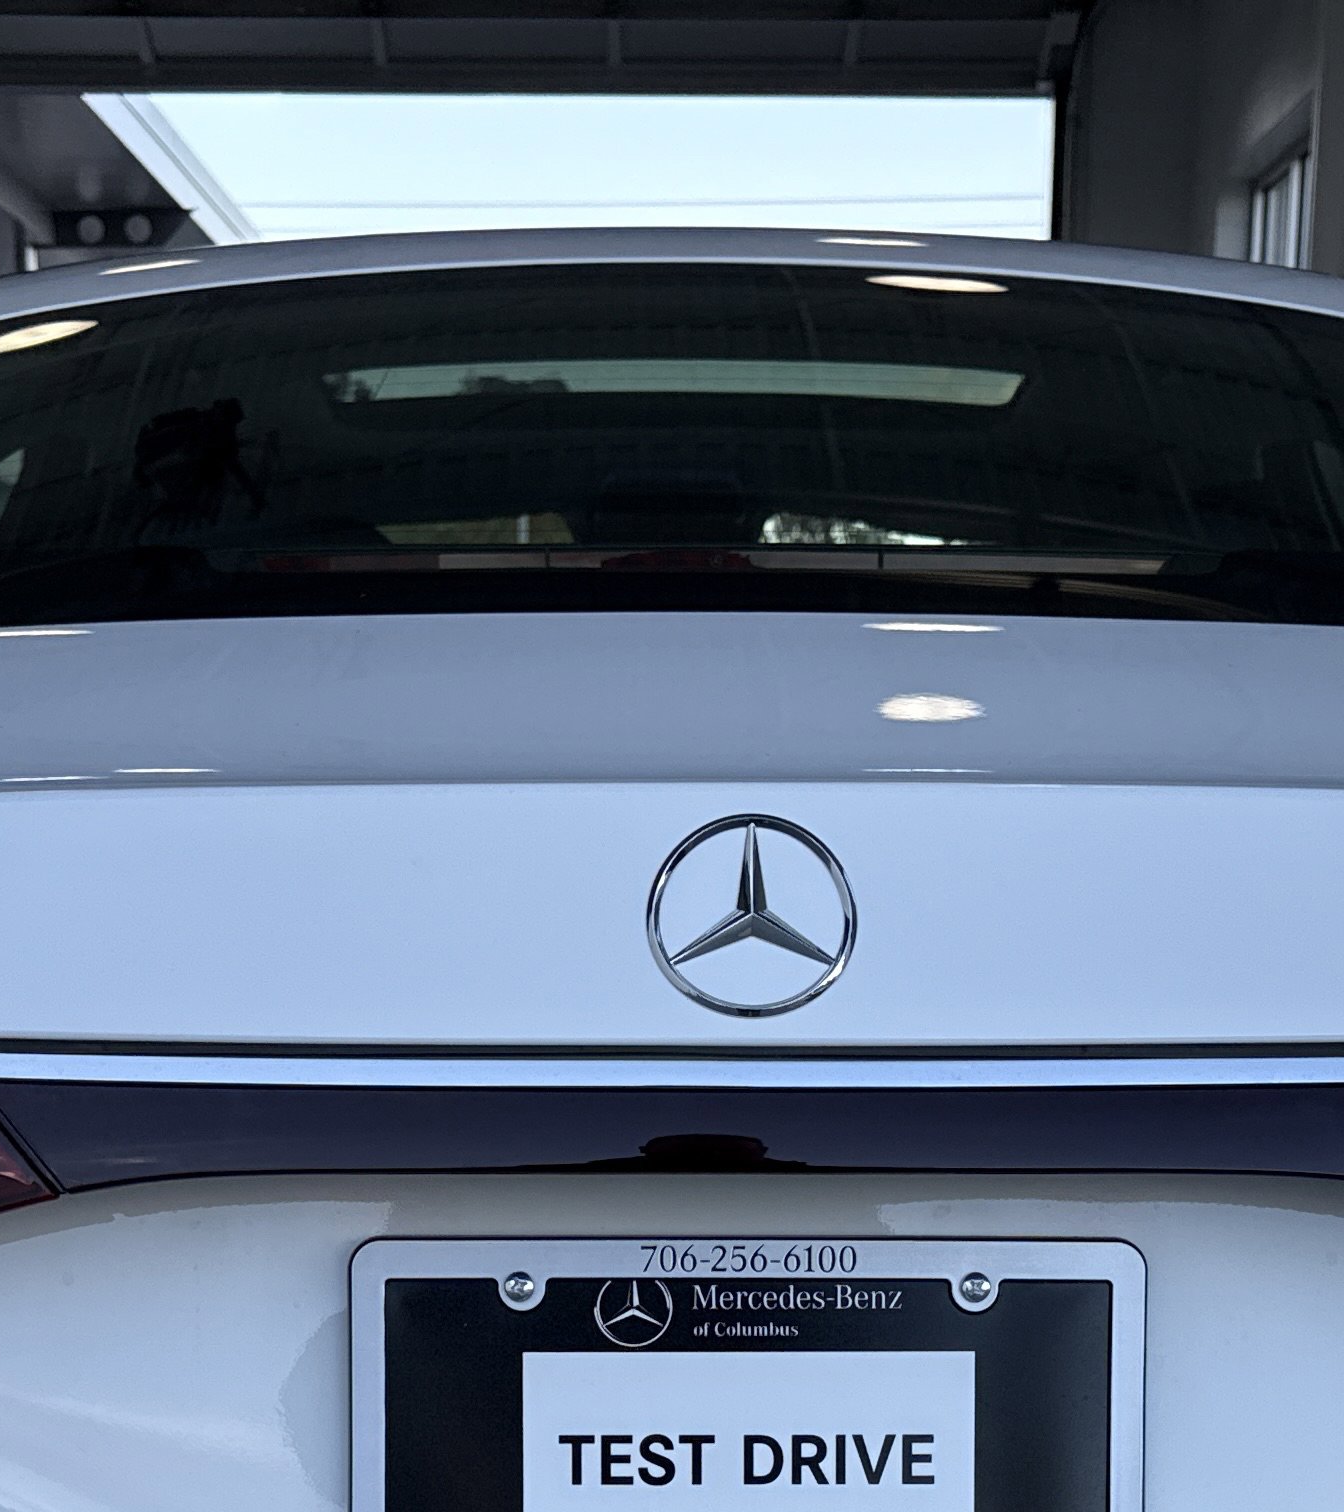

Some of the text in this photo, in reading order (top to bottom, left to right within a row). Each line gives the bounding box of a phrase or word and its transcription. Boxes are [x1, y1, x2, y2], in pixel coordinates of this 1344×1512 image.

[640, 1244, 858, 1274] 706-256-6100
[691, 1283, 903, 1311] Mercedes-Benz
[693, 1321, 800, 1337] of Columbus
[558, 1434, 935, 1486] TEST DRIVE
